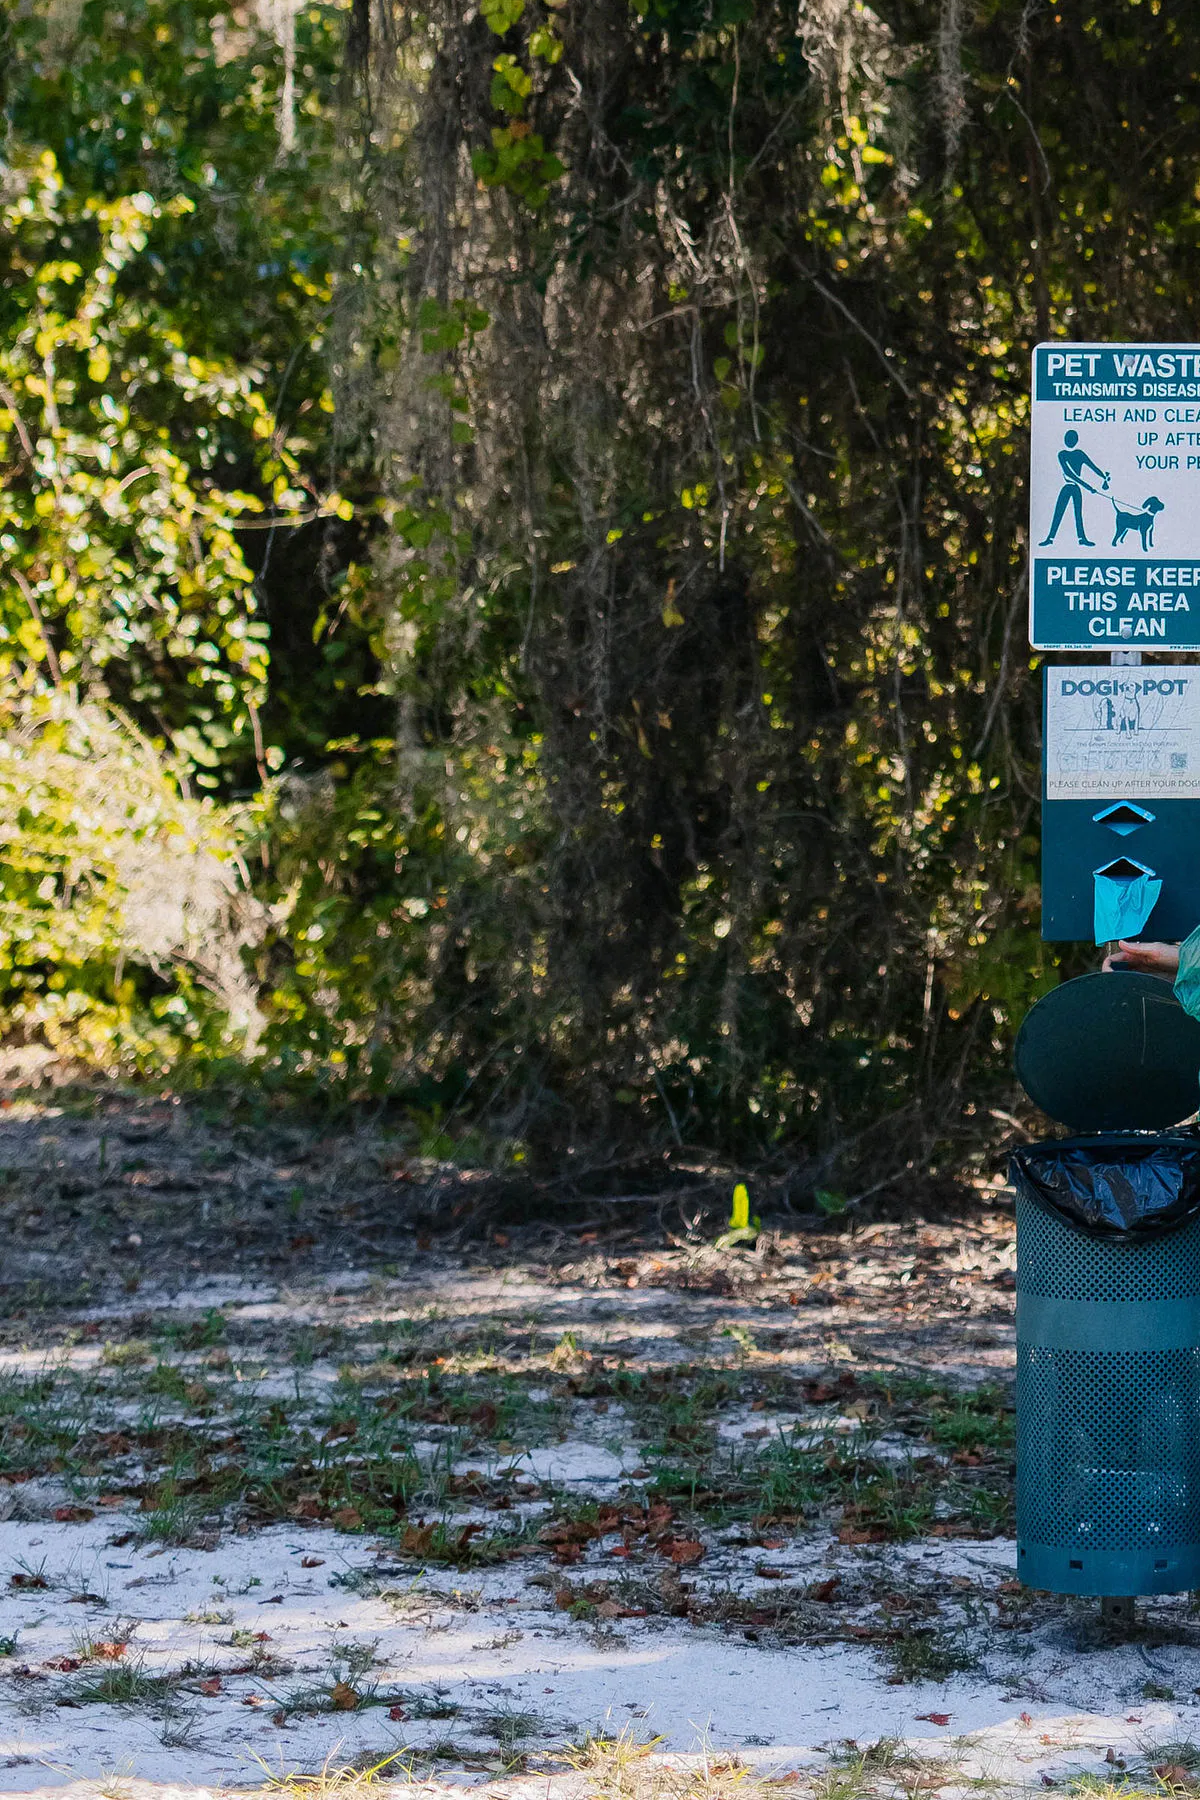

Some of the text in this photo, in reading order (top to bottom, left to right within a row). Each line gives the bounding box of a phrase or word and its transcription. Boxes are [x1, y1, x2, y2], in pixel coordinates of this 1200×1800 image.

[1047, 354, 1101, 377] PET
[1052, 383, 1137, 397] TRANSMITS
[1063, 408, 1116, 422] LEASH
[1123, 409, 1157, 422] AND
[1137, 432, 1158, 446] UP
[1136, 455, 1179, 469] YOUR
[1047, 566, 1136, 586] PLEASE
[1064, 591, 1190, 612] THIS AREA
[1088, 617, 1166, 637] CLEAN
[1049, 780, 1200, 788] PLEASE CLEAN UP AFTER YOUR DOG!
